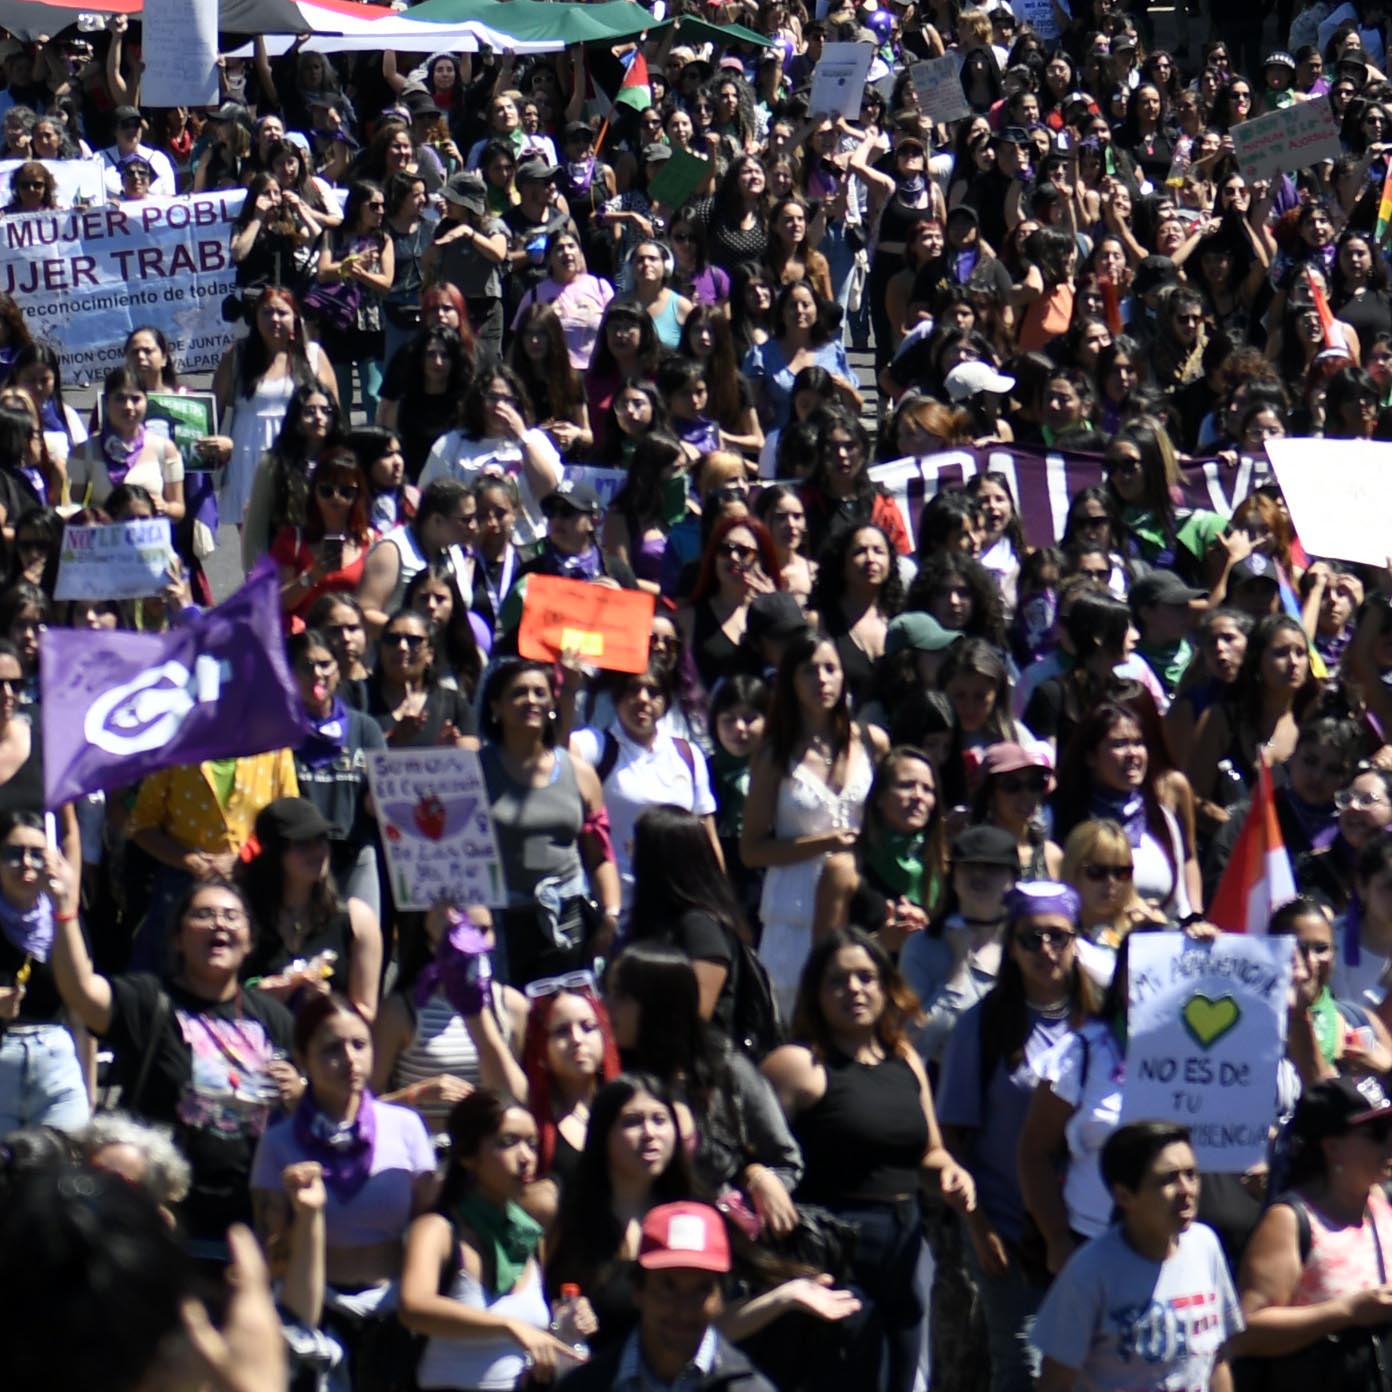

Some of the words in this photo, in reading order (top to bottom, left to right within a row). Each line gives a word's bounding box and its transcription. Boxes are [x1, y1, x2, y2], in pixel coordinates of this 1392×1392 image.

[8, 209, 130, 250] MUJER
[110, 239, 237, 283] TRAB
[20, 288, 158, 317] reconocimiento
[165, 285, 185, 302] de
[191, 280, 236, 298] todas
[190, 334, 234, 350] JUNTA
[73, 370, 84, 382] Y
[1138, 1058, 1177, 1084] NO
[1183, 1056, 1214, 1085] ES
[1172, 1090, 1203, 1114] TU
